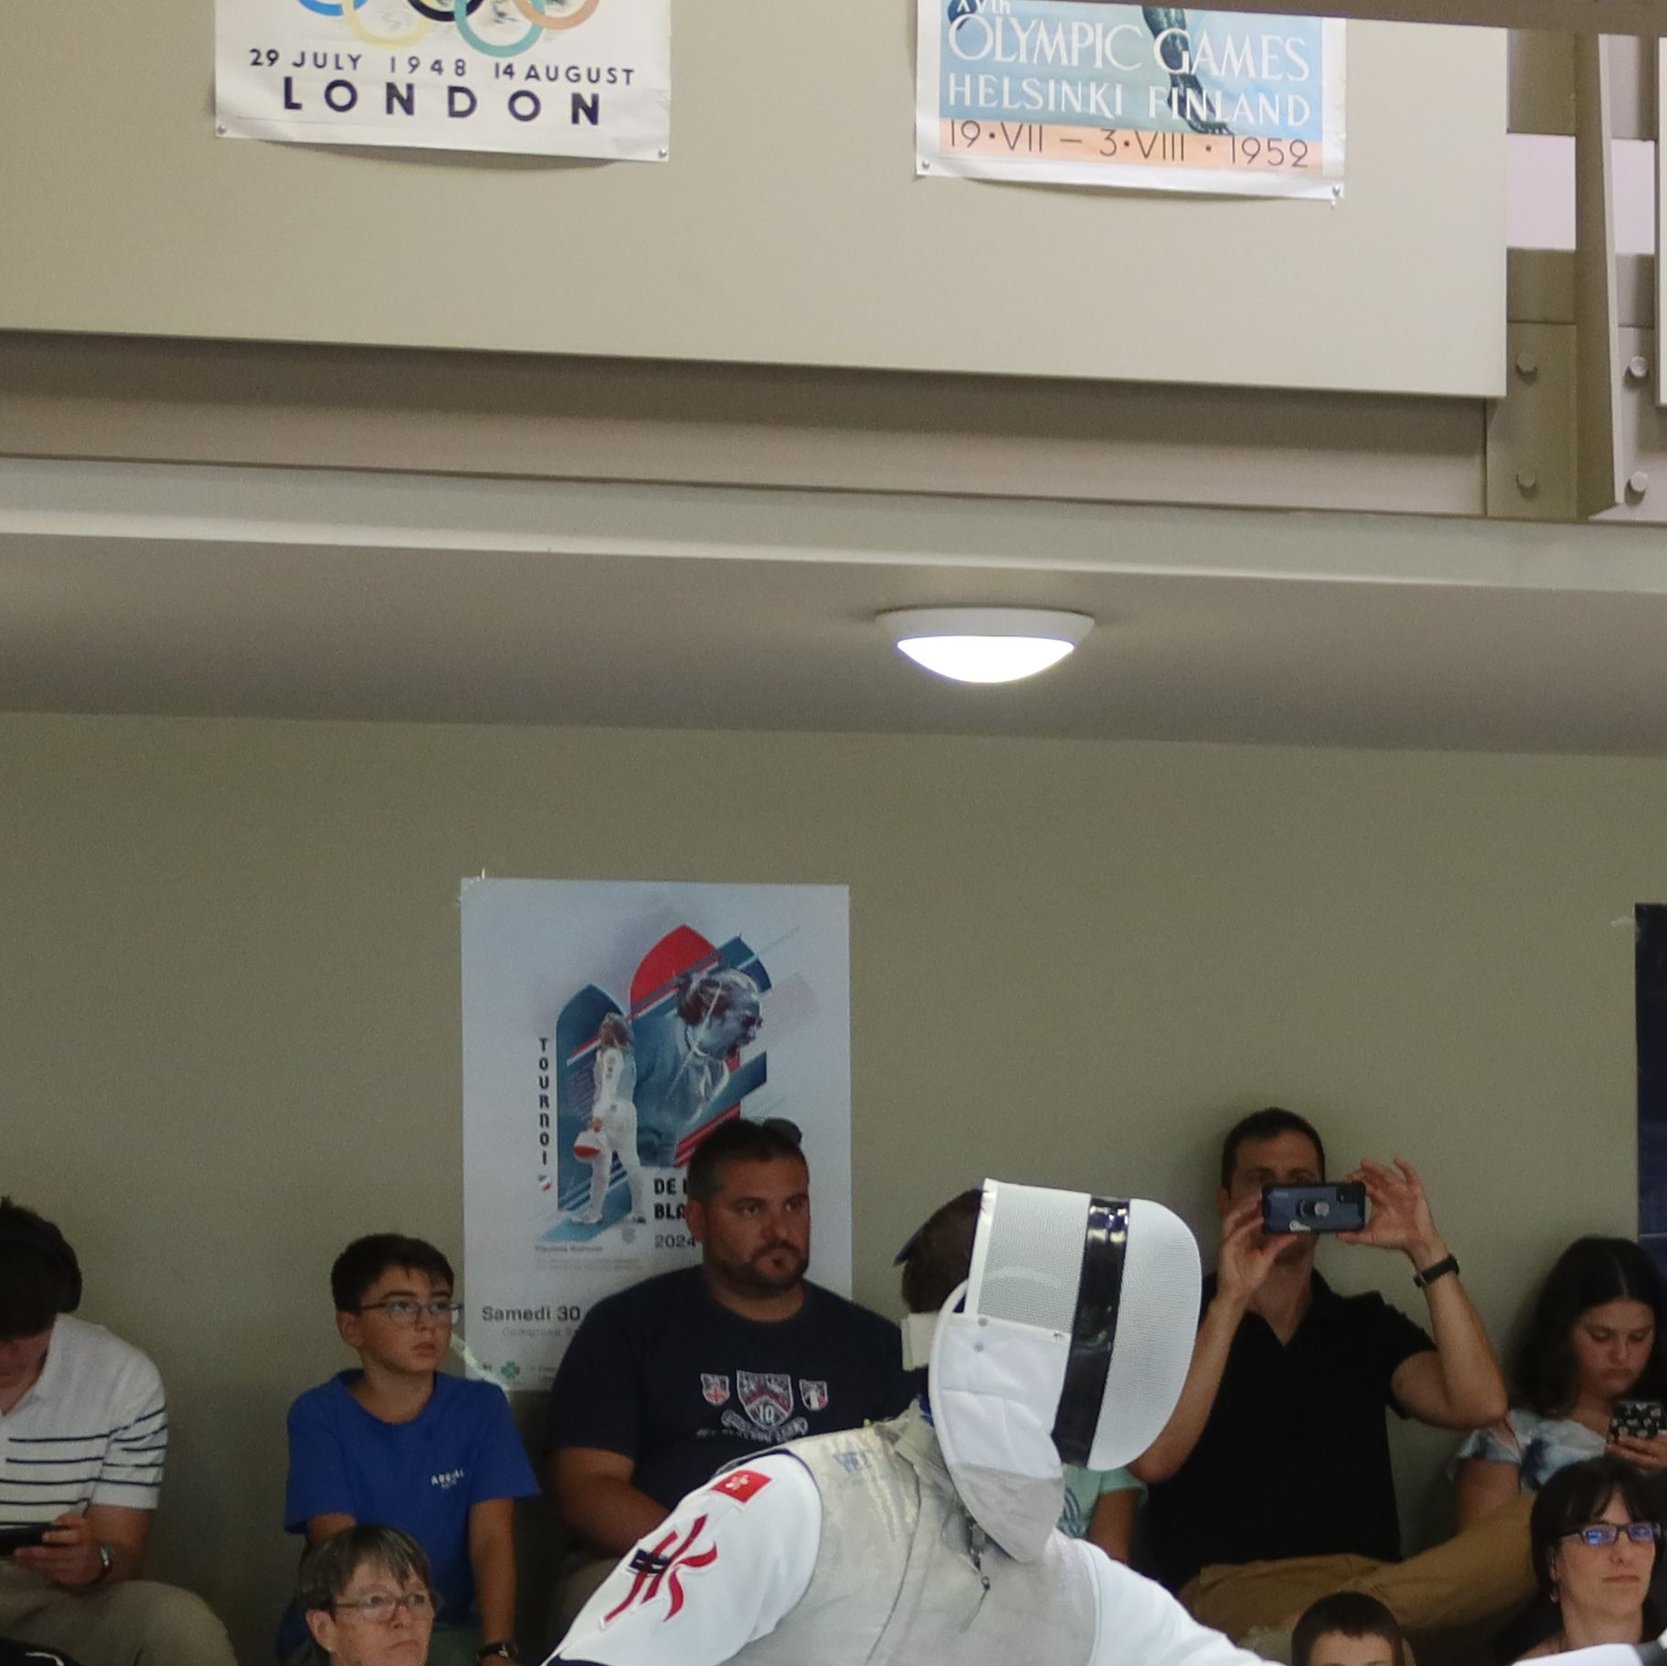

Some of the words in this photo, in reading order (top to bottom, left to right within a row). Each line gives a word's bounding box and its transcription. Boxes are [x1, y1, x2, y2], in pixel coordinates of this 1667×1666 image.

[948, 14, 1142, 72] OLYMPIC
[1153, 29, 1311, 82] GAMES
[249, 48, 280, 67] 29
[292, 50, 362, 71] JULY
[390, 55, 467, 77] 1948
[494, 61, 515, 80] 14
[525, 64, 635, 85] AUGUST
[283, 76, 600, 126] LONDON
[949, 73, 1123, 119] HELSINKI
[1149, 84, 1311, 127] FINLAND
[1228, 135, 1309, 168] 1952
[653, 1177, 677, 1195] DE
[654, 1233, 696, 1249] 2024
[481, 1305, 552, 1322] Samedi
[557, 1305, 581, 1321] 30
